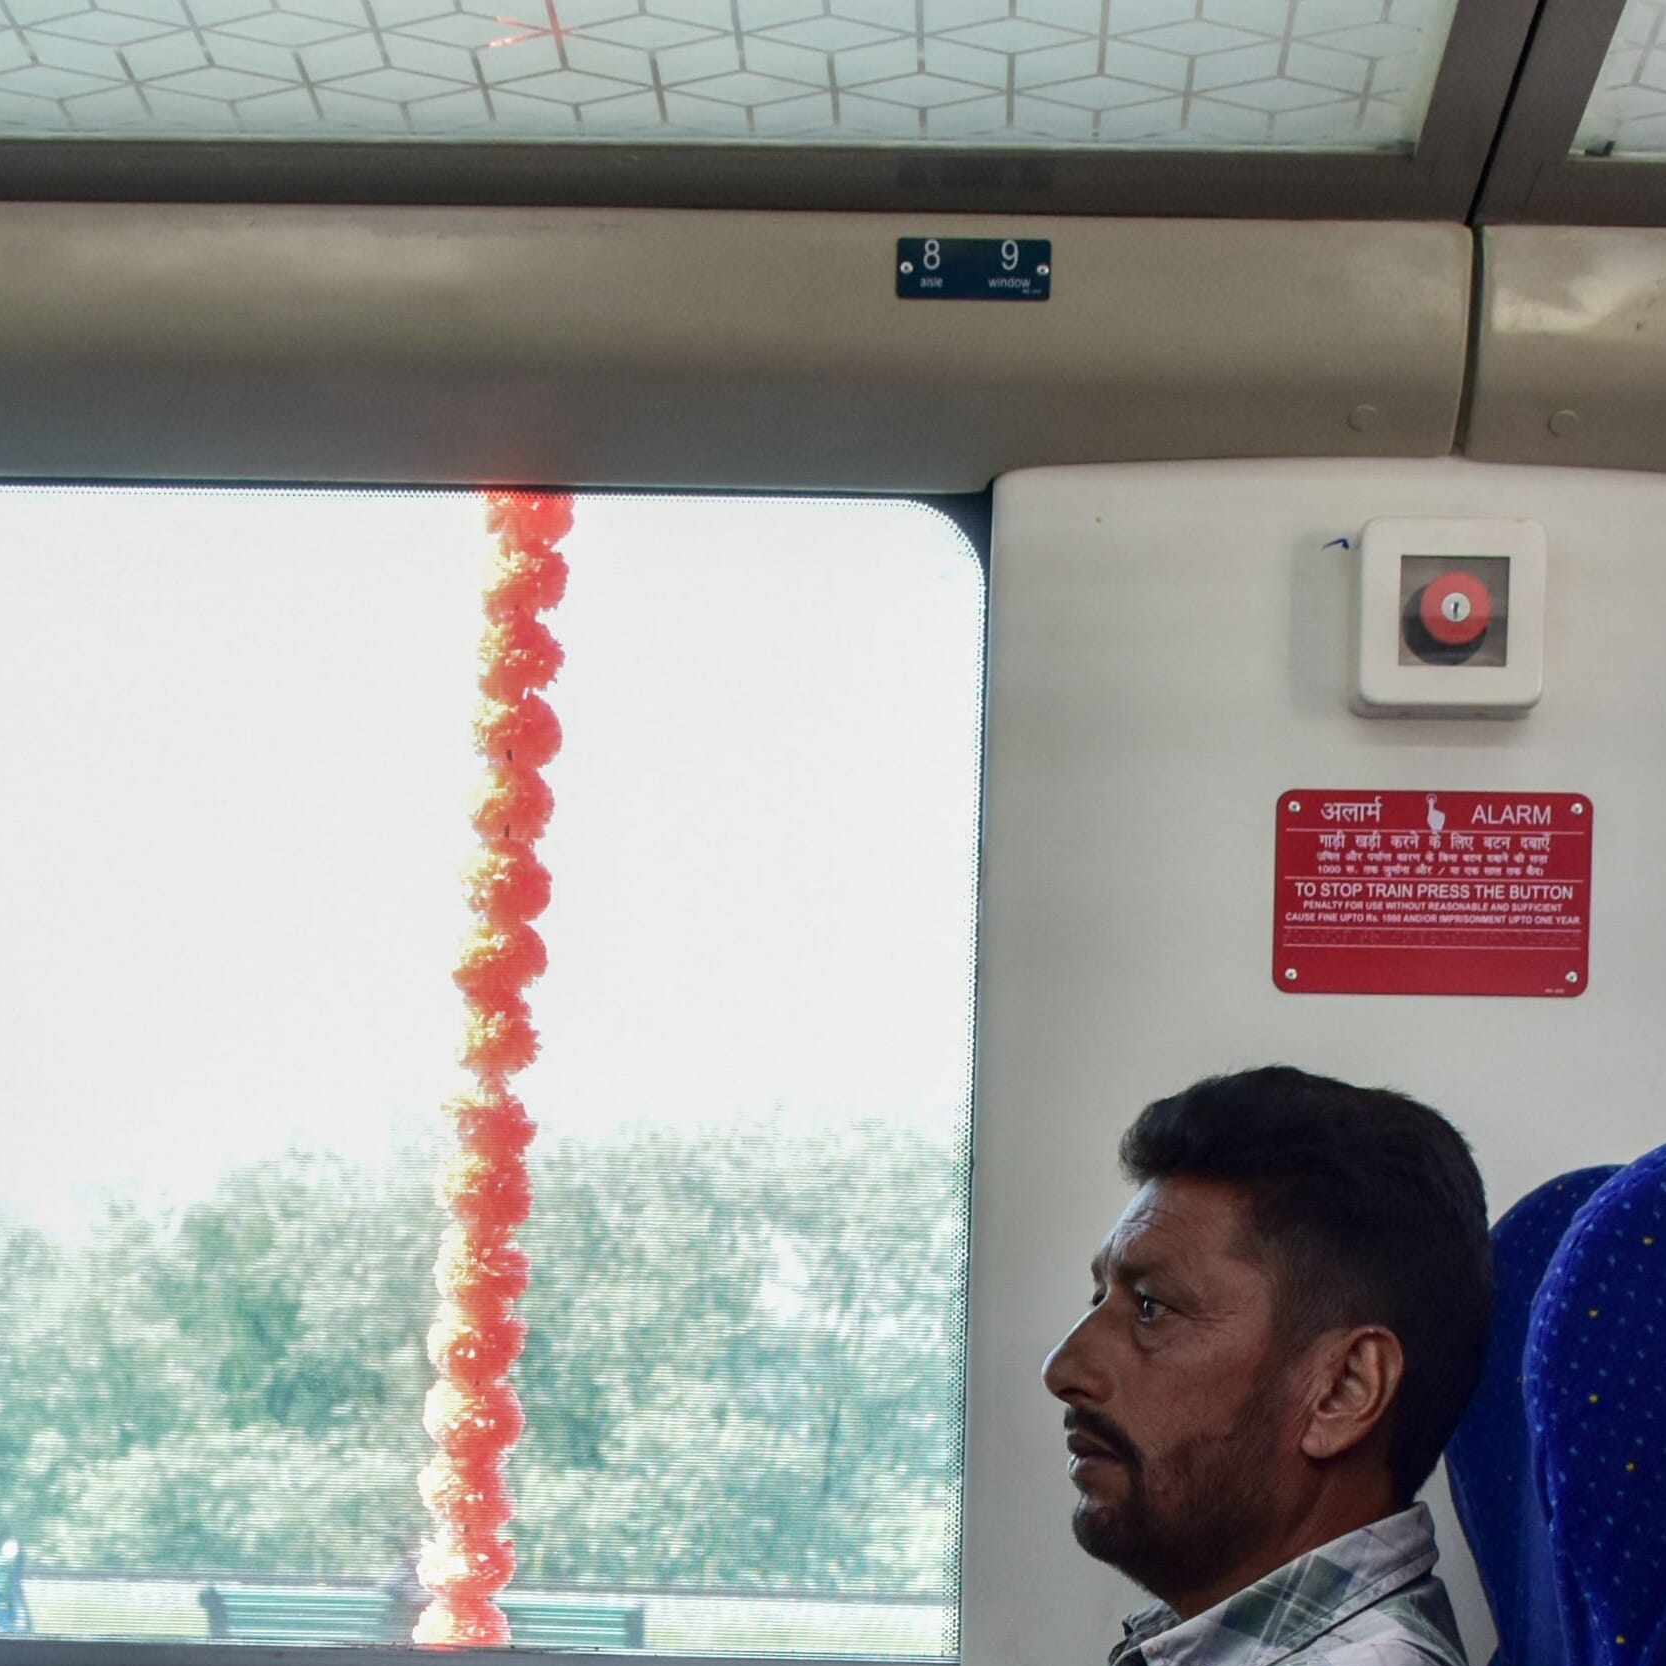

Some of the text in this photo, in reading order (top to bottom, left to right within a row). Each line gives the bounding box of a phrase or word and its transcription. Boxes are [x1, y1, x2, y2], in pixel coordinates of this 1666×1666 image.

[923, 239, 1019, 271] 8 9
[920, 277, 1031, 288] aisle window
[1320, 796, 1383, 823] अलार्म
[1471, 804, 1552, 825] ALARM
[1390, 831, 1421, 850] करने
[1429, 831, 1442, 849] के
[1450, 832, 1474, 851] लिए
[1482, 836, 1511, 850] बटन
[1318, 865, 1341, 873] 1000
[1295, 882, 1573, 900] TO STOP TRAIN PRESS THE BUTTON
[1303, 900, 1562, 913] PENALTY FOR USE WITHOUT REASONABLE AND SUFFICIENT
[1285, 912, 1317, 922] CAUSE
[1318, 912, 1339, 922] FINE
[1340, 913, 1364, 923] UPTO
[1439, 914, 1507, 924] IMPRISONMENT
[1508, 915, 1532, 924] UPTO
[1534, 915, 1554, 924] ONE
